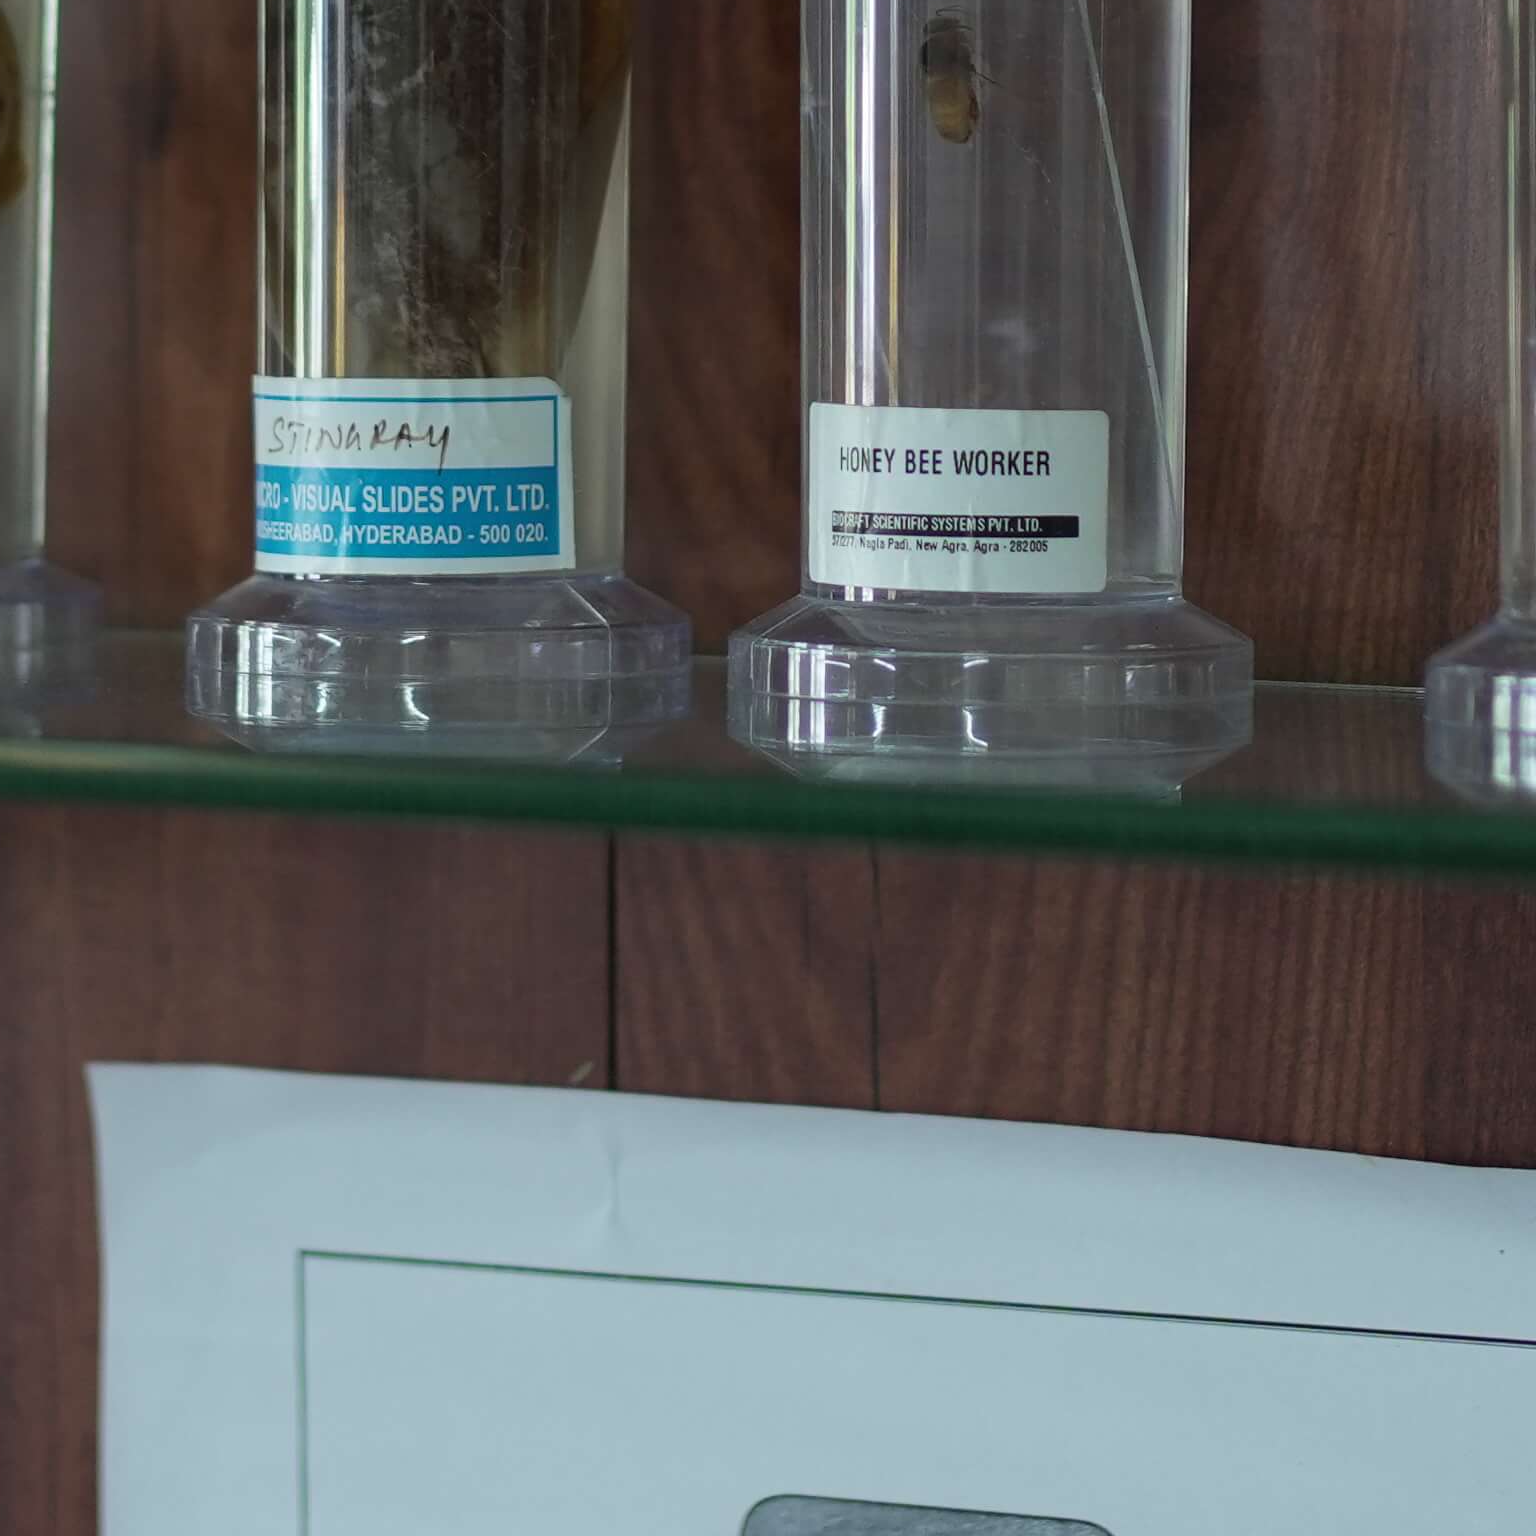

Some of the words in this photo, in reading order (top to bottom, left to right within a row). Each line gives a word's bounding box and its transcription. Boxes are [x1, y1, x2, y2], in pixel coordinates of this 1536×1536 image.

[840, 446, 896, 474] HONEY
[905, 449, 943, 475] BEE
[953, 450, 1051, 477] WORKER
[291, 483, 357, 513] VISUAL
[362, 484, 444, 513] SLIDES
[451, 484, 500, 513] PVT.
[506, 483, 550, 512] LTD.
[343, 523, 463, 545] HYDERABAD
[480, 524, 511, 544] 500
[516, 522, 549, 543] 020.
[872, 514, 929, 531] SCIENTIFIC
[931, 515, 985, 532] SYSTEMS
[988, 517, 1015, 532] PVT.
[1017, 517, 1043, 533] LTD.
[916, 539, 938, 551] New
[973, 539, 1000, 554] Agra
